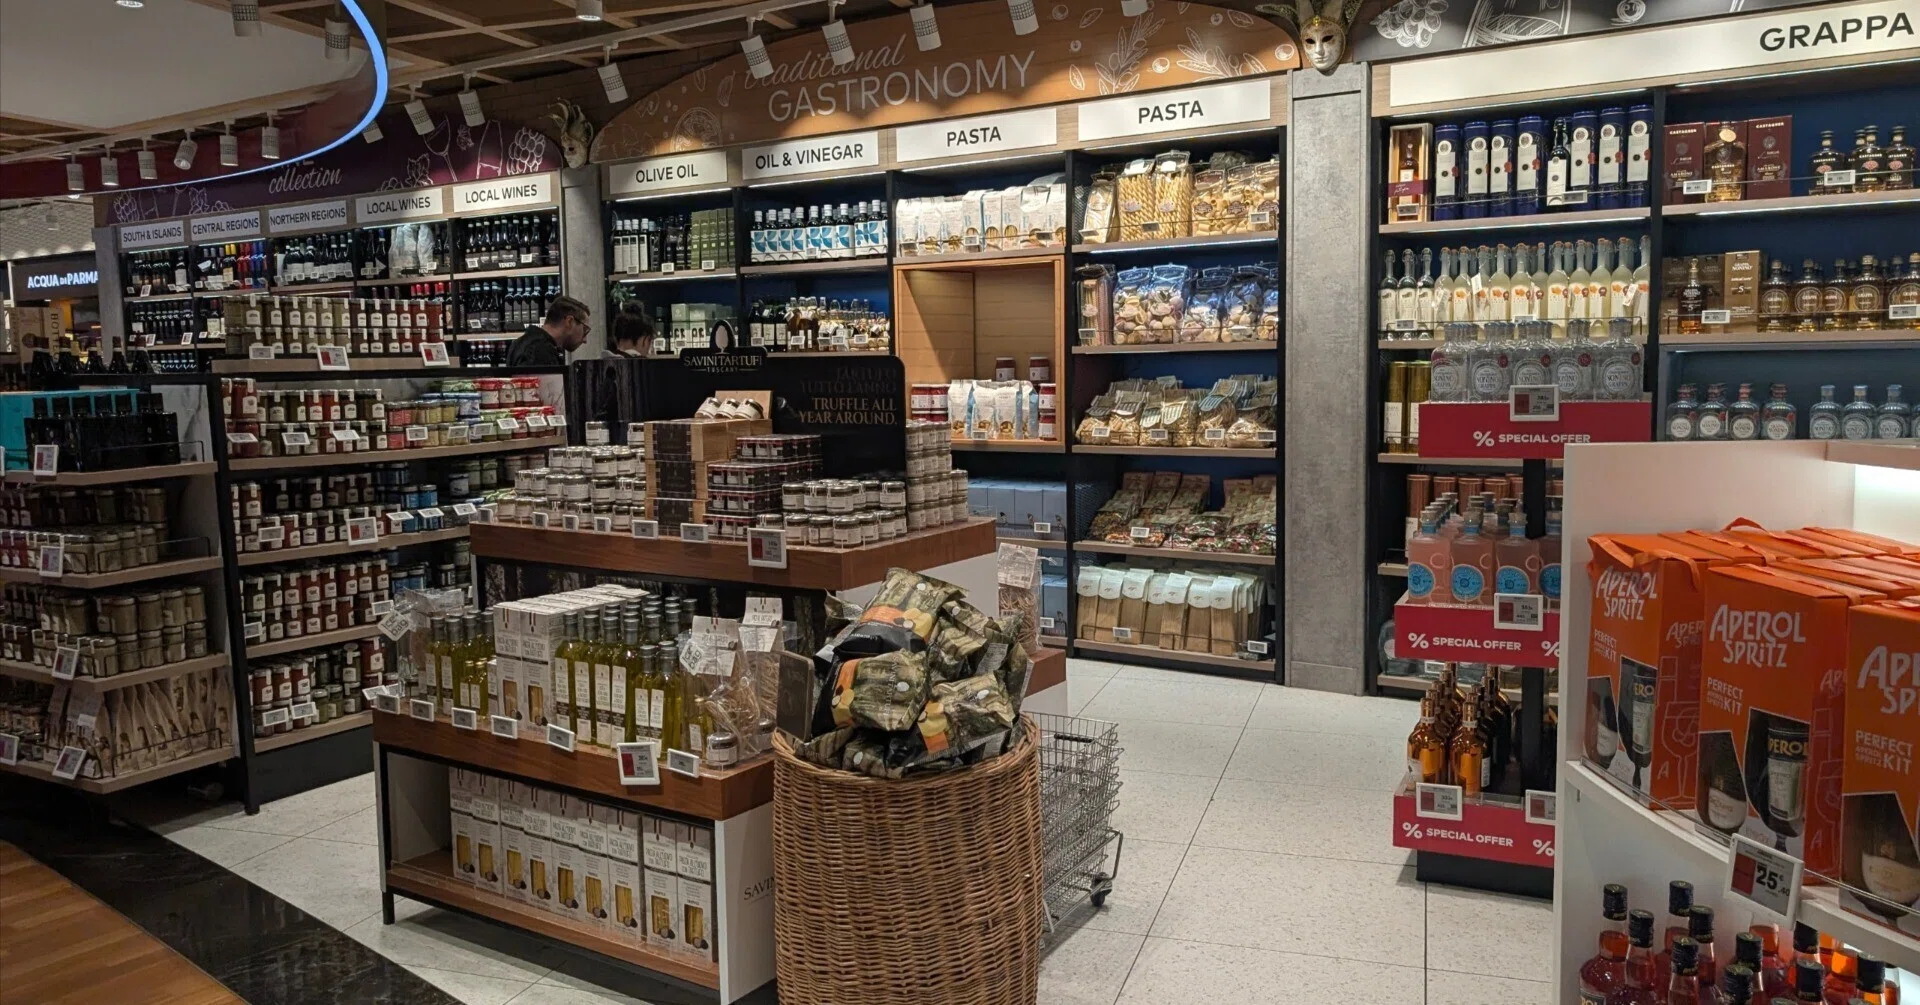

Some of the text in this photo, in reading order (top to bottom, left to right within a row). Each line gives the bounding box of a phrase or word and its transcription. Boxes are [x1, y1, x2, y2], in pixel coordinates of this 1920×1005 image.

[1759, 12, 1915, 52] GRAPPA
[768, 50, 1036, 122] GASTRONOMY
[1138, 100, 1204, 124] PASTA
[946, 126, 1001, 147] PASTA
[755, 143, 863, 170] OIL & VINEGAR
[269, 166, 343, 194] collection
[636, 164, 698, 183] OLIVE OIL
[466, 184, 537, 204] LOCAL WINES
[367, 197, 431, 215] LOCAL WINES
[192, 217, 259, 235] CENTRAL REGIONS
[270, 208, 346, 226] NORTHERN REGIONS
[123, 226, 182, 242] SOUTH & ISLANDS
[27, 274, 59, 288] ACQUA
[50, 313, 59, 362] BOTTEG
[812, 397, 897, 411] TRUFFLE ALL
[799, 411, 898, 425] YEAR AROUND.
[1498, 434, 1548, 444] SPECIAL
[1550, 434, 1591, 444] OFFER
[1596, 565, 1657, 599] APEROL
[1666, 620, 1705, 642] APER
[1709, 604, 1807, 643] APEROL
[1432, 636, 1481, 648] SPECIAL
[1483, 639, 1522, 651] OFFER
[1594, 629, 1617, 649] PERFECT
[1605, 647, 1617, 663] KIT
[1707, 676, 1744, 700] PERFECT
[1724, 700, 1743, 716] KIT
[1855, 730, 1913, 757] PERFECT
[1883, 753, 1912, 775] KIT
[1426, 827, 1473, 843] SPECIAL
[1475, 834, 1514, 847] OFFER
